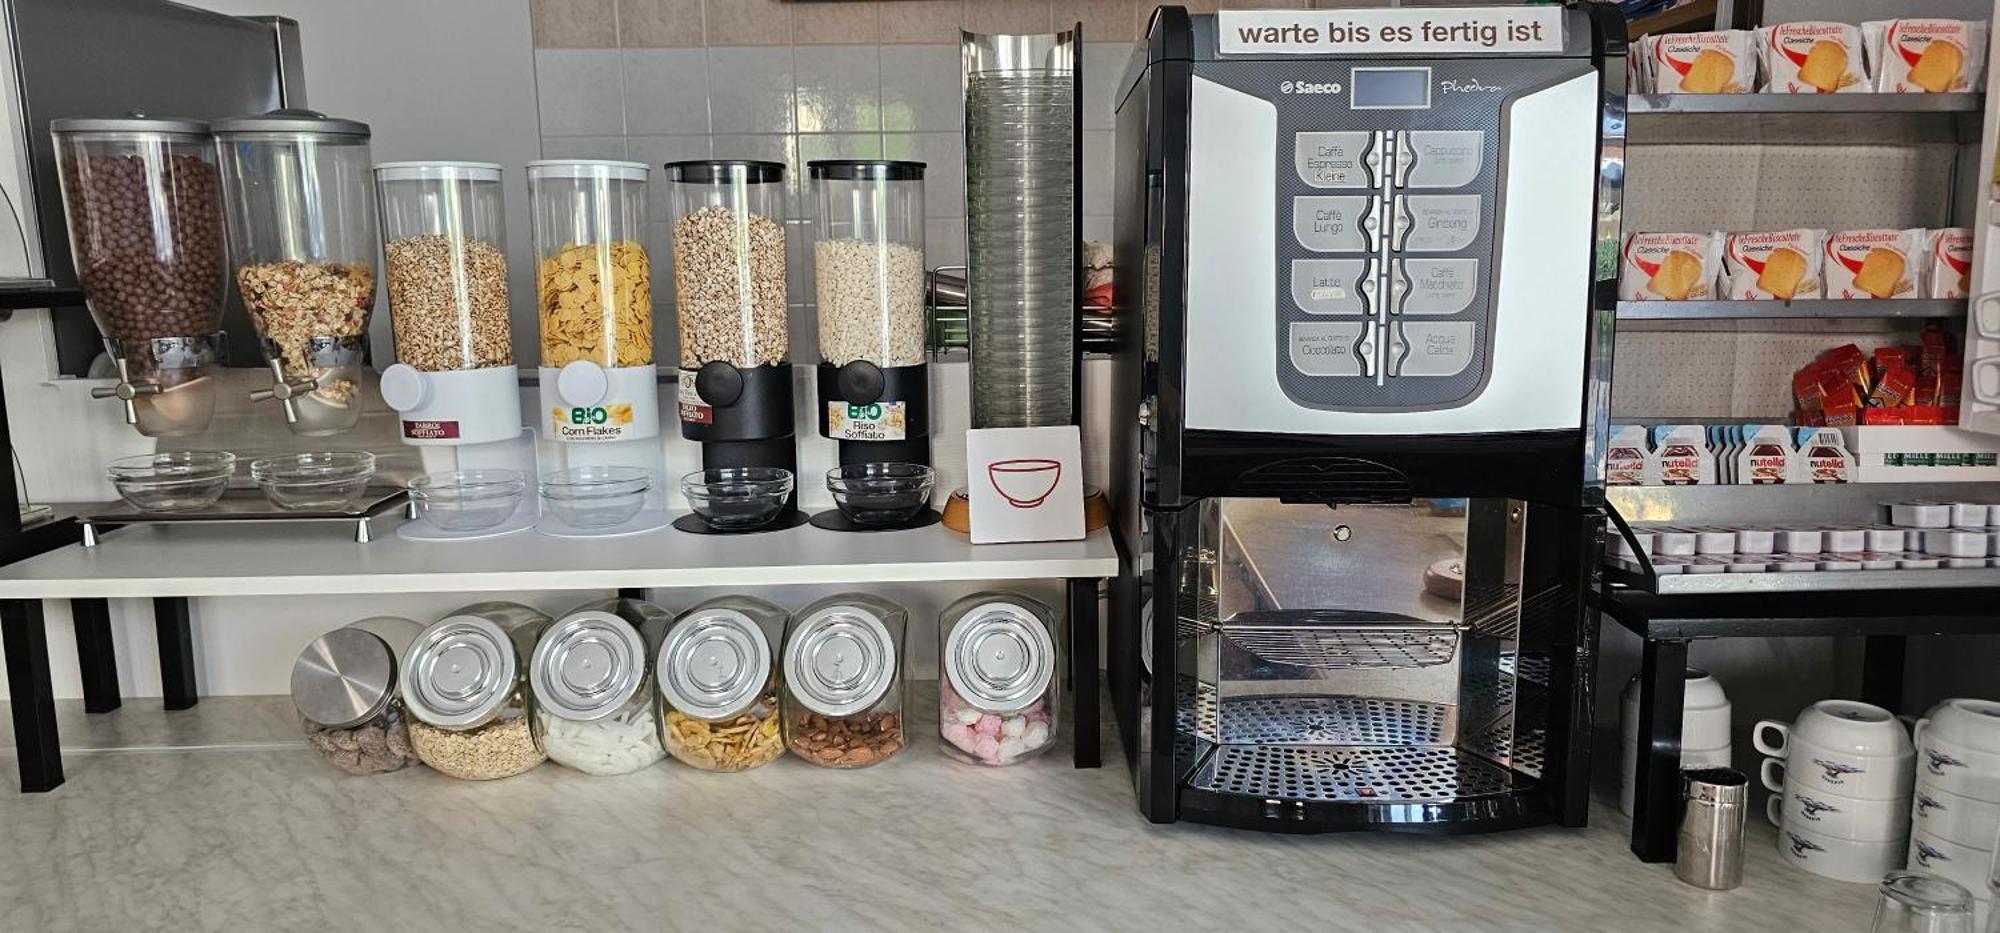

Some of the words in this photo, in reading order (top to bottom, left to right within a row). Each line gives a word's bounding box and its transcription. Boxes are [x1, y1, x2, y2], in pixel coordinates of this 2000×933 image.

[1238, 23, 1319, 44] warte
[1329, 22, 1370, 43] bis
[1380, 25, 1413, 43] es
[1421, 21, 1497, 46] fertig
[1508, 20, 1542, 42] ist
[1296, 81, 1341, 94] Saeco
[853, 421, 876, 430] Riso
[586, 426, 622, 436] Flakes
[844, 429, 886, 439] Soffiato
[1662, 458, 1698, 468] nutella
[1750, 457, 1785, 467] nutella
[1810, 459, 1845, 468] nutella
